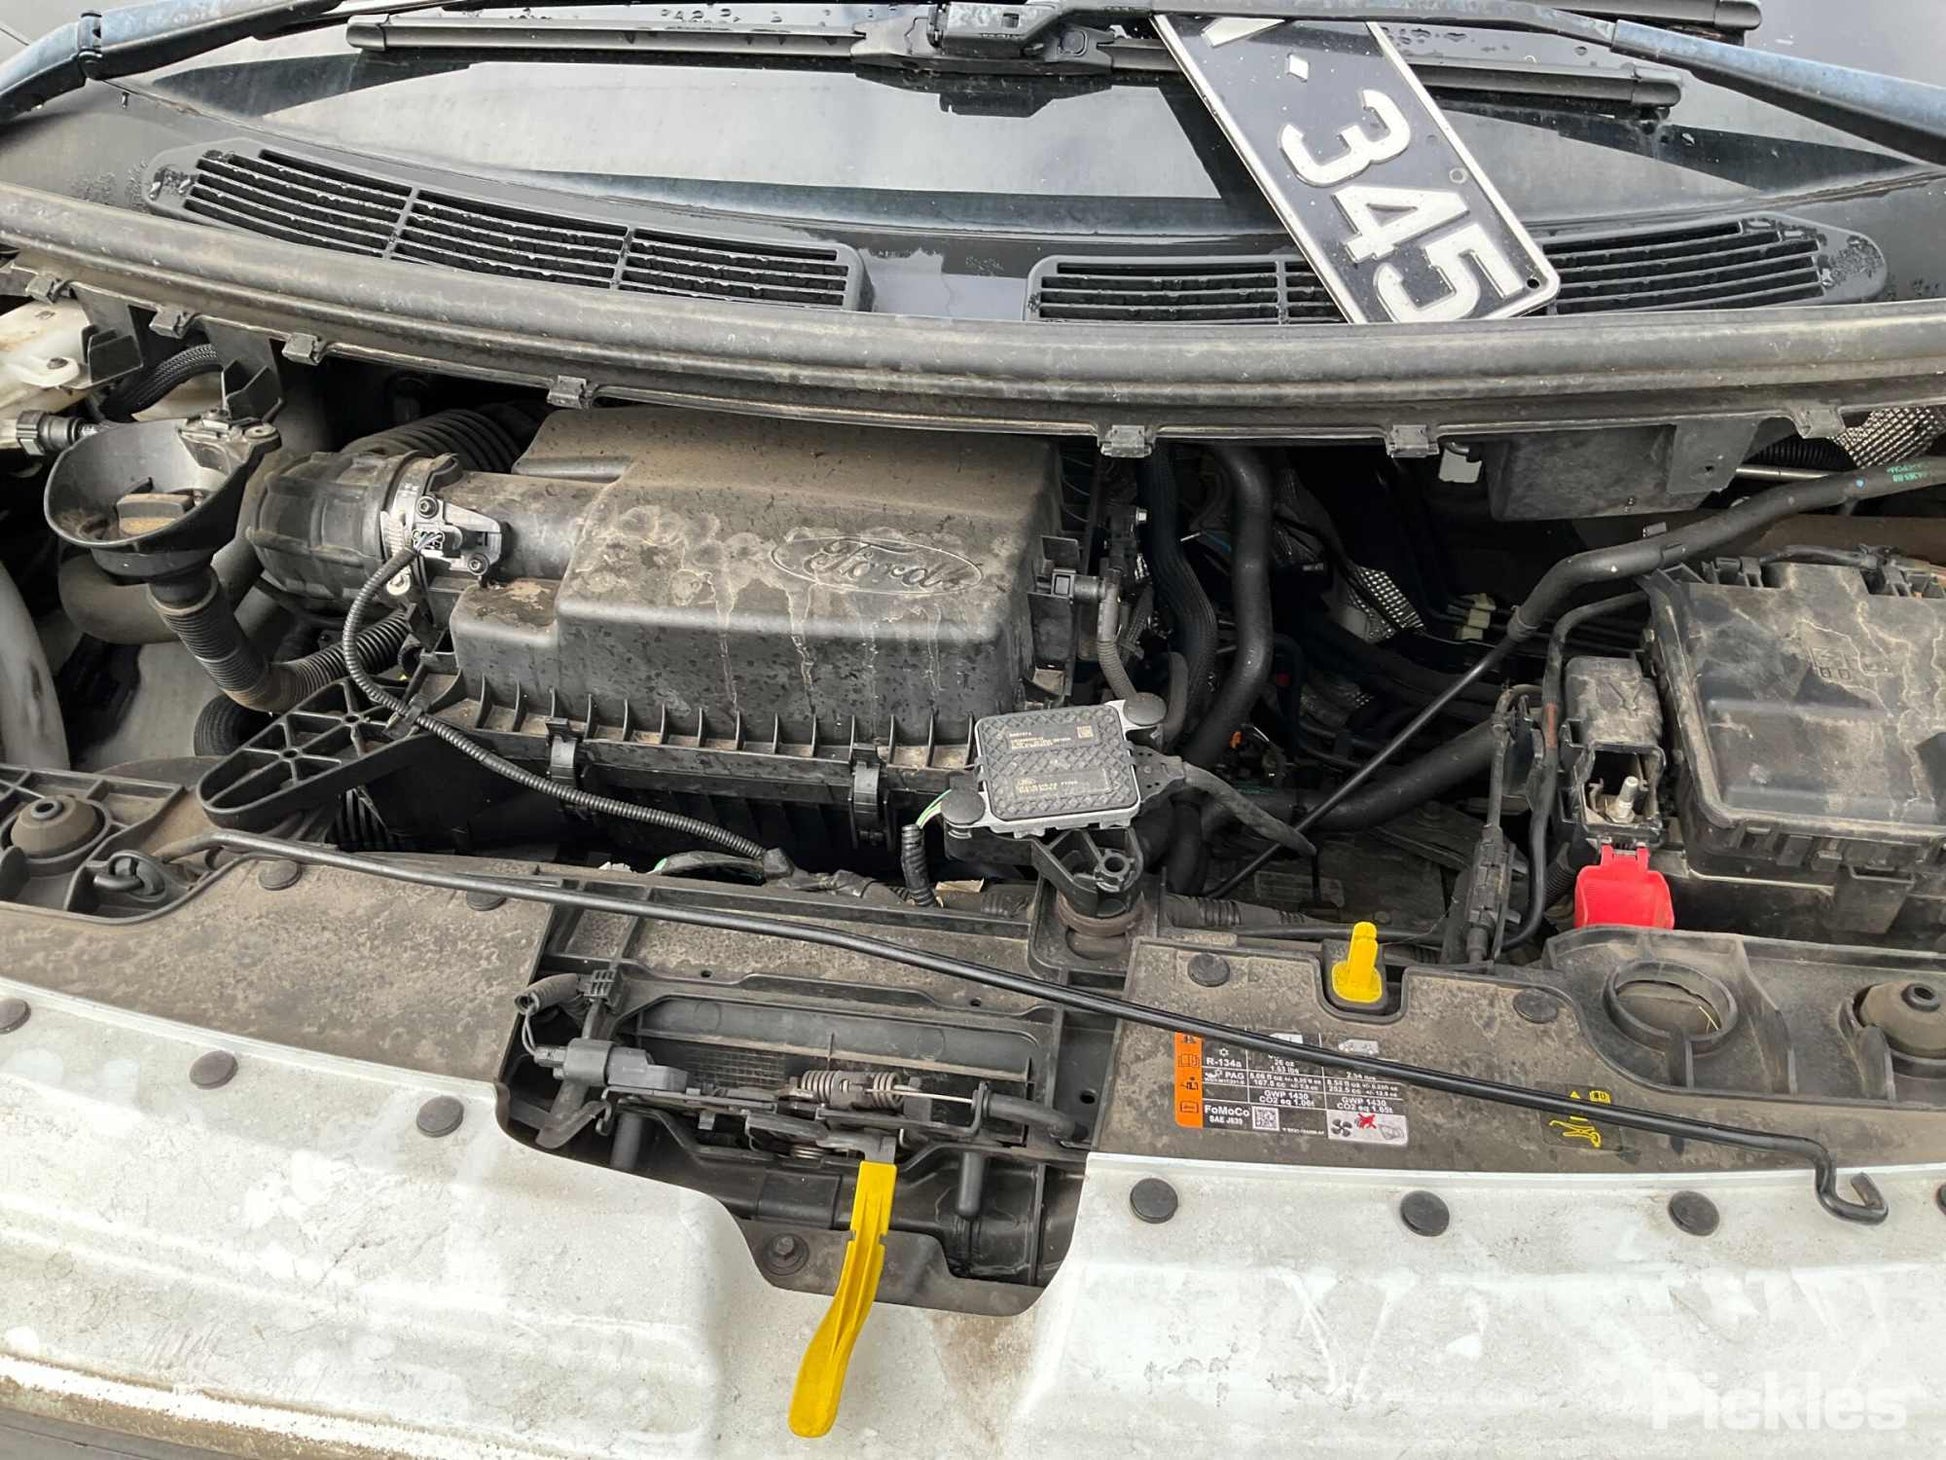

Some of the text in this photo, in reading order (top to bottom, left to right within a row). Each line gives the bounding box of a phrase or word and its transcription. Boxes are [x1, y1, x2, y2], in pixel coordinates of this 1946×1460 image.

[1206, 1058, 1242, 1067] R-134a
[1225, 1072, 1244, 1080] PAG
[1264, 1090, 1286, 1098] GWP
[1259, 1096, 1278, 1104] CO2
[1336, 1102, 1356, 1110] CO2
[1204, 1105, 1250, 1117] FoMoCo
[1209, 1115, 1225, 1124] SAE
